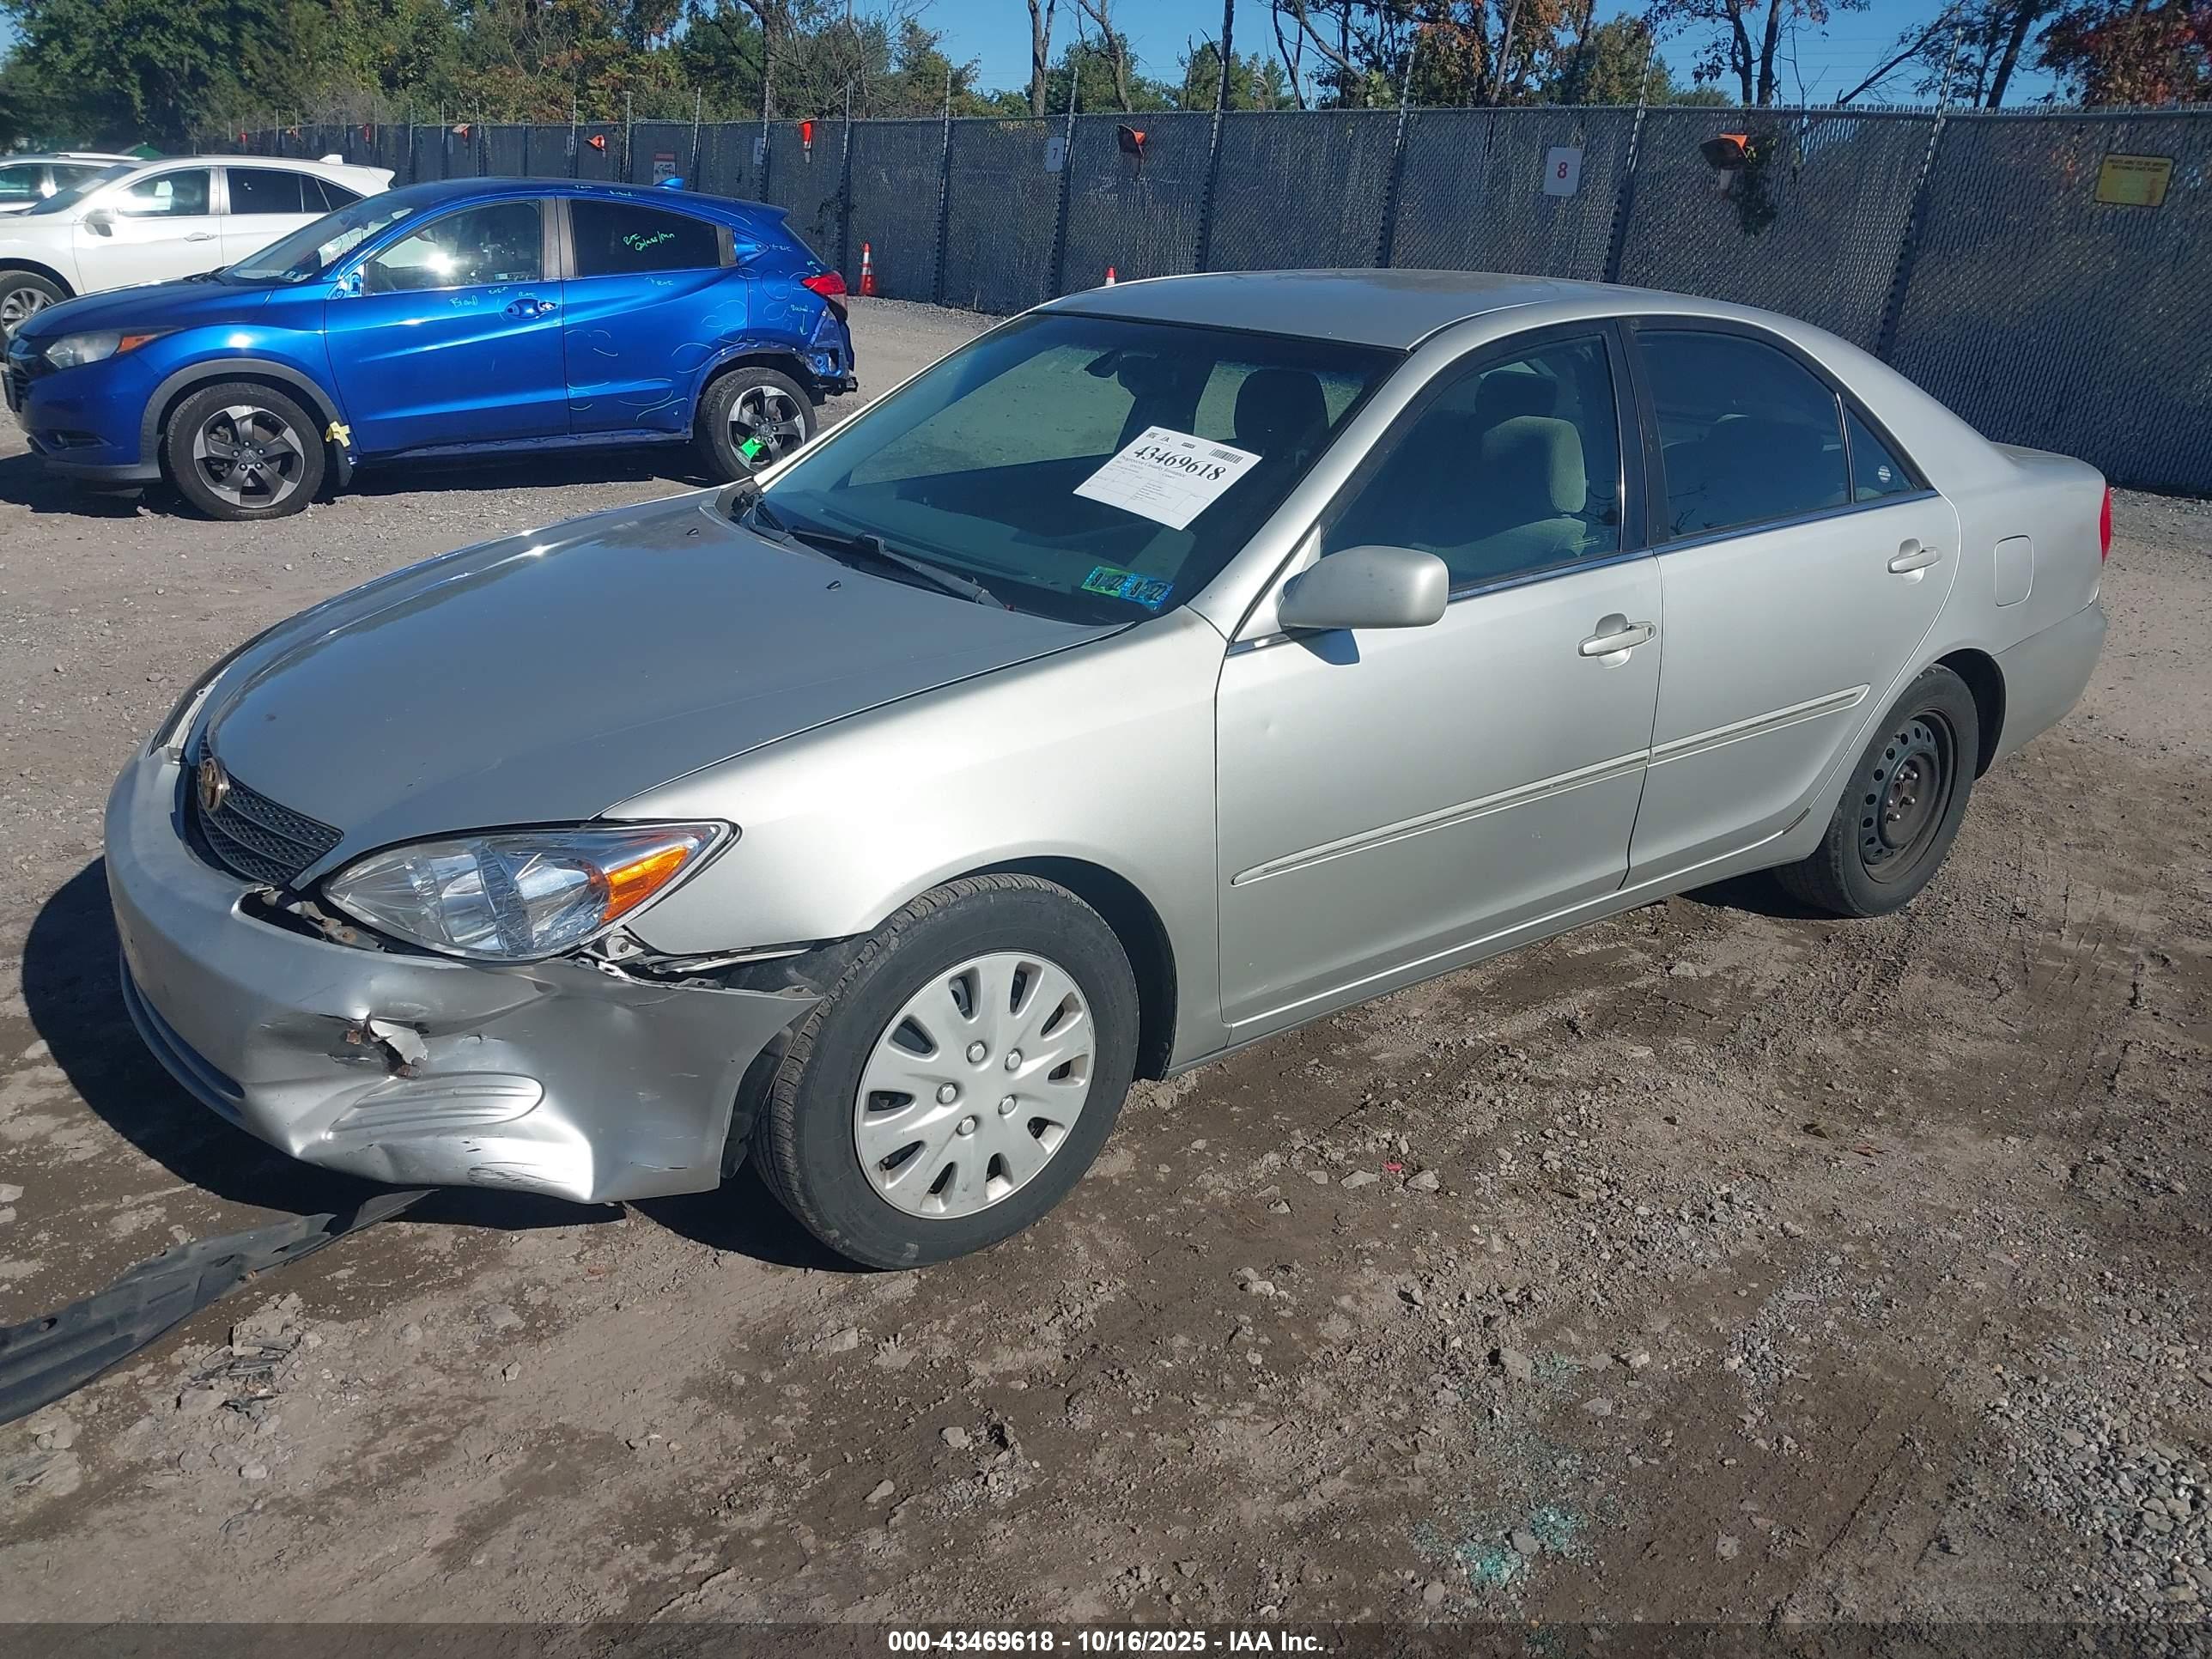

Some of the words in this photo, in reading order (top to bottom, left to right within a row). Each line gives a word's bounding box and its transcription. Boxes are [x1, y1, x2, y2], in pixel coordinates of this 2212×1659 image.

[1053, 148, 1058, 159] 7
[1557, 161, 1568, 179] 8
[1133, 446, 1226, 481] 43469618
